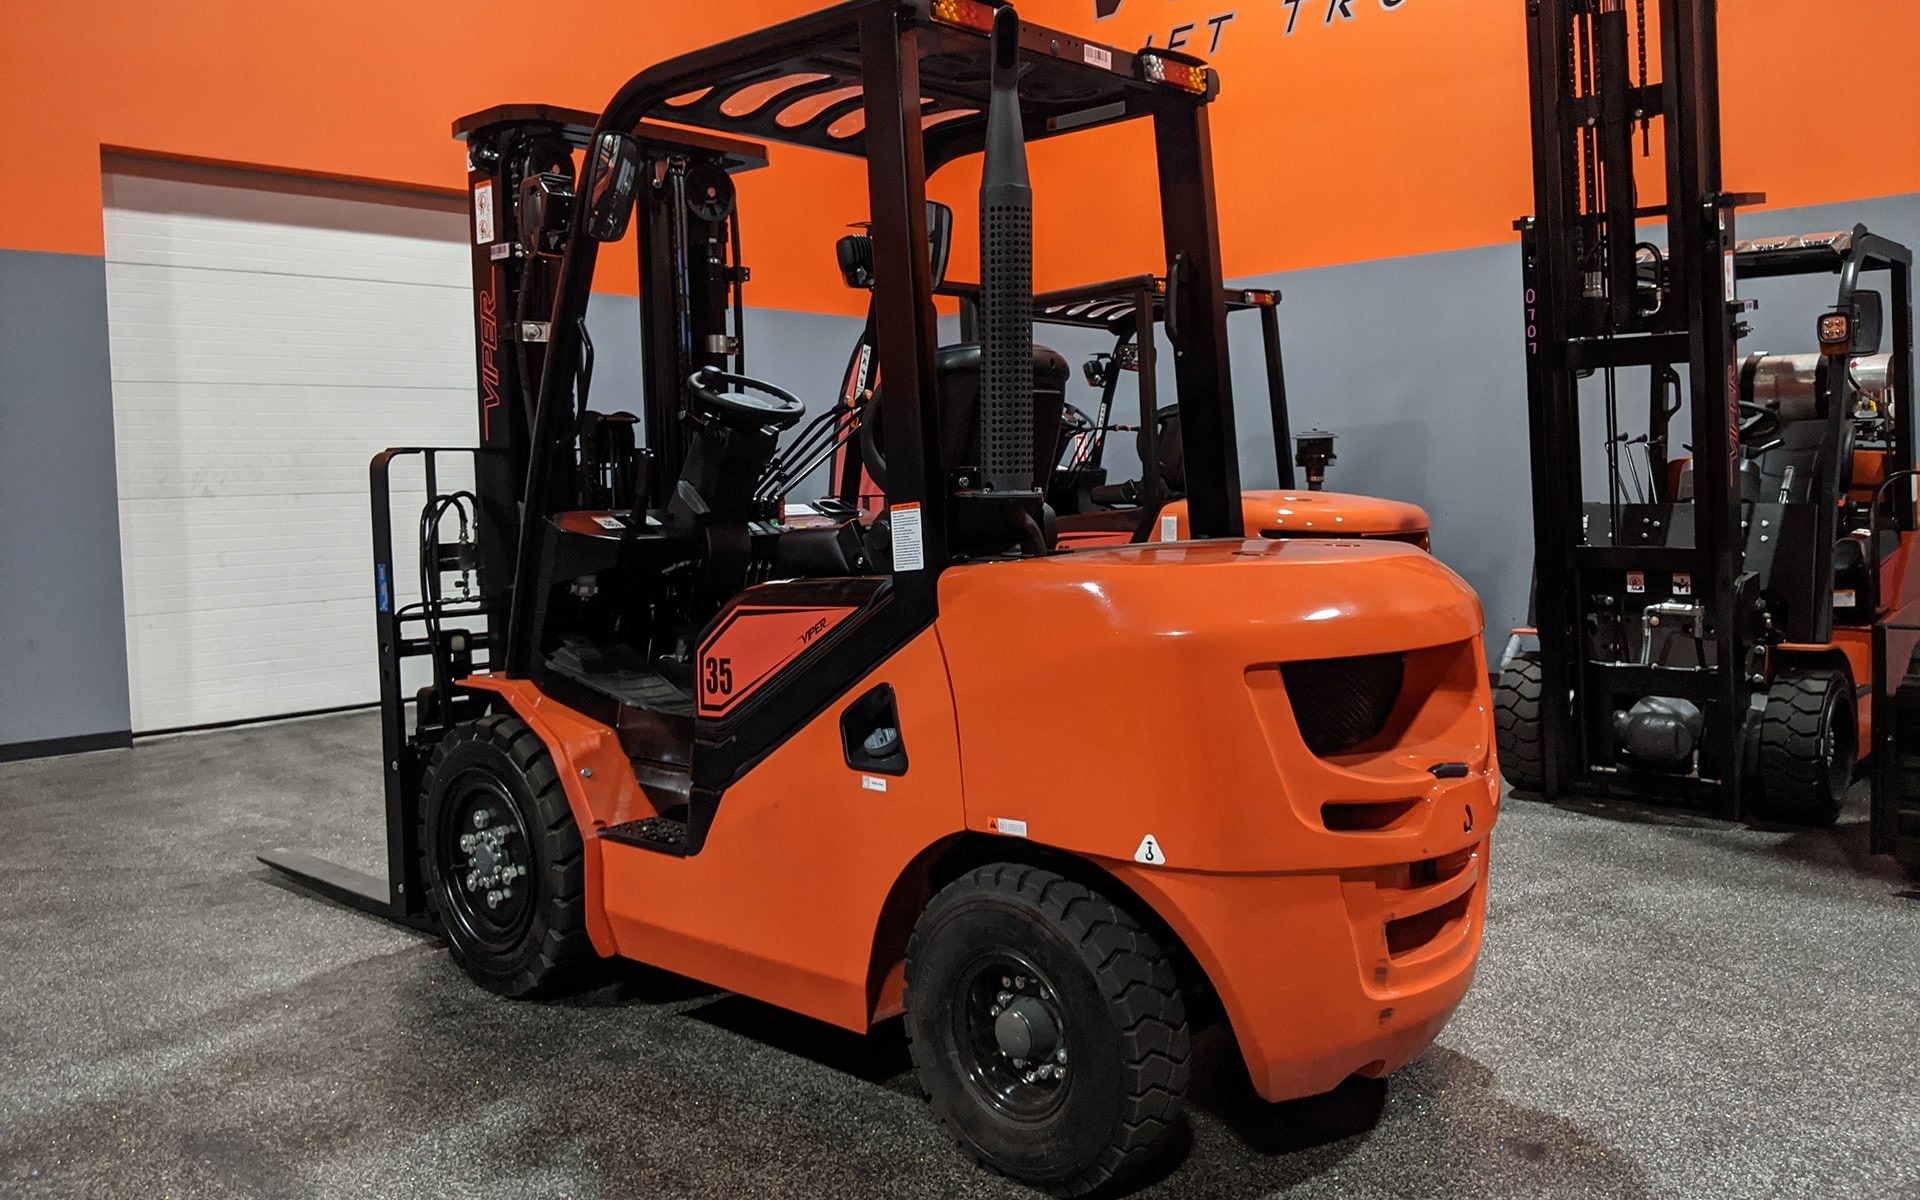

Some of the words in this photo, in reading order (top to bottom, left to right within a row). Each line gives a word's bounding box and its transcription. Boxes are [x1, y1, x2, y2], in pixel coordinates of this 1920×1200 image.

[479, 288, 500, 408] VIPER
[799, 617, 828, 645] VIPER
[705, 656, 733, 695] 35
